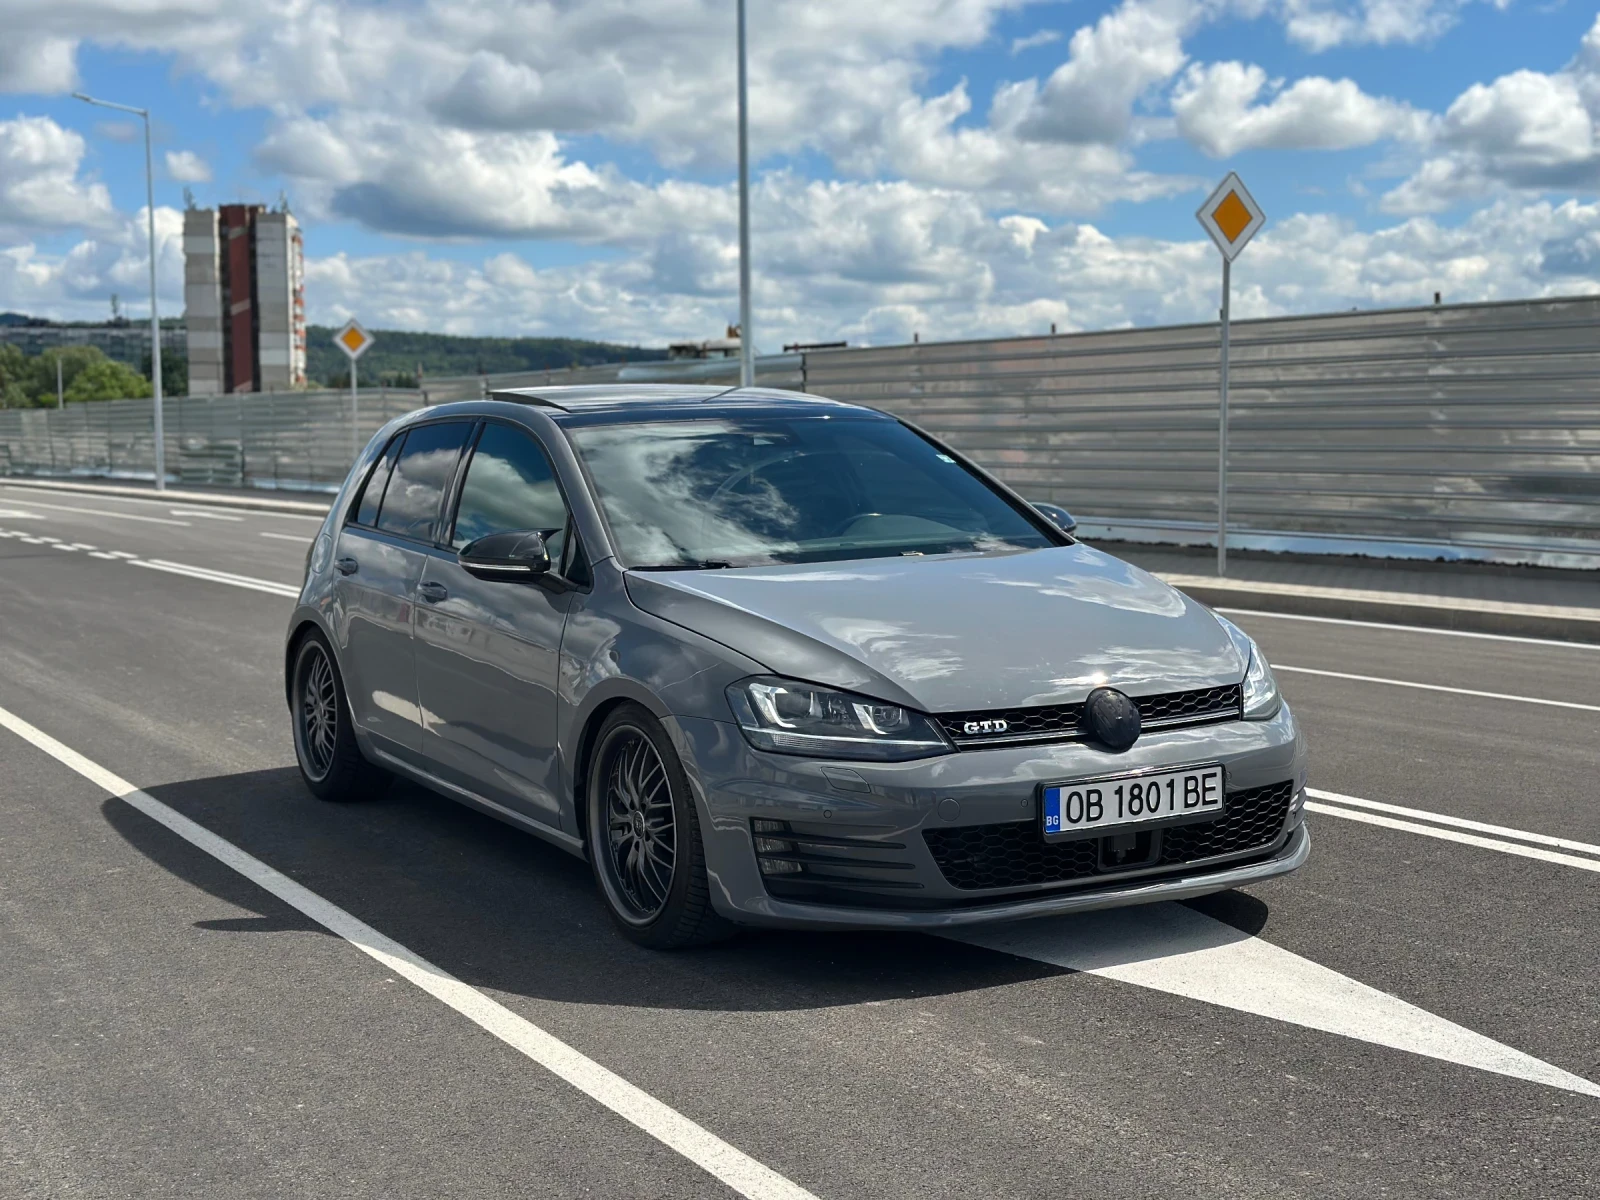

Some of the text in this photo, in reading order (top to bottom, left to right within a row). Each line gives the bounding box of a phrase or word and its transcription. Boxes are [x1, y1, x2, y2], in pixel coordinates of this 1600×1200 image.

[963, 719, 1008, 735] GTD
[1066, 772, 1218, 824] OB 1801 BE
[1046, 815, 1059, 826] BG
